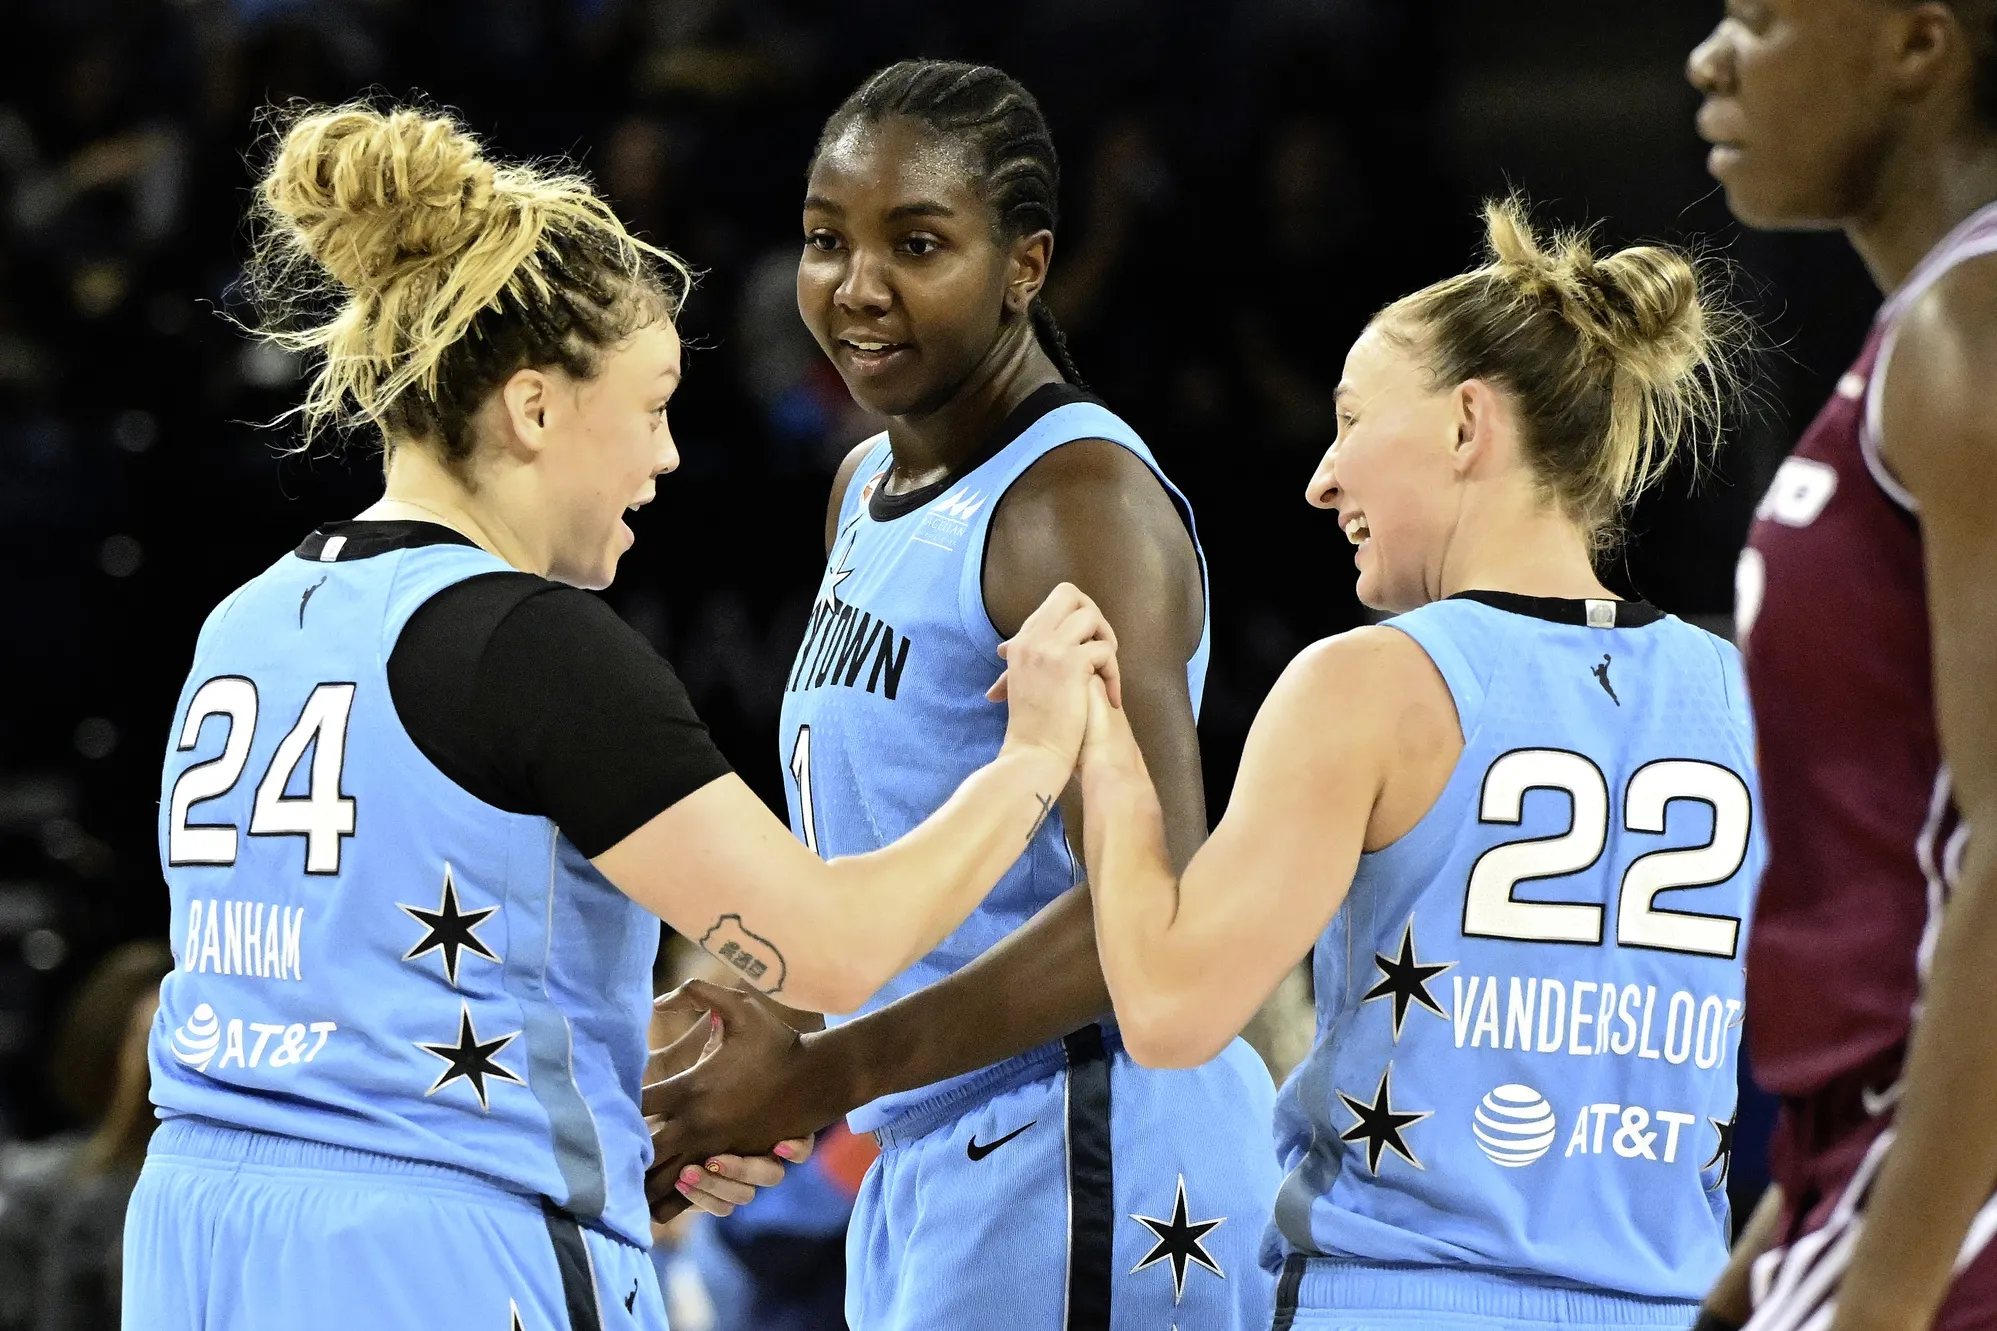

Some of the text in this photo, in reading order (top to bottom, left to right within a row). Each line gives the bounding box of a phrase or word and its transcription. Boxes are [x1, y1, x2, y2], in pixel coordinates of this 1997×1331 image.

[784, 597, 912, 701] YTOWN
[169, 674, 357, 876] 24
[789, 724, 820, 858] 1
[1461, 746, 1752, 960] 22
[184, 899, 304, 981] BANHAM
[220, 1018, 338, 1070] AT&T
[1452, 975, 1742, 1070] VANDERSLOOT
[1565, 1102, 1696, 1164] AT&T
